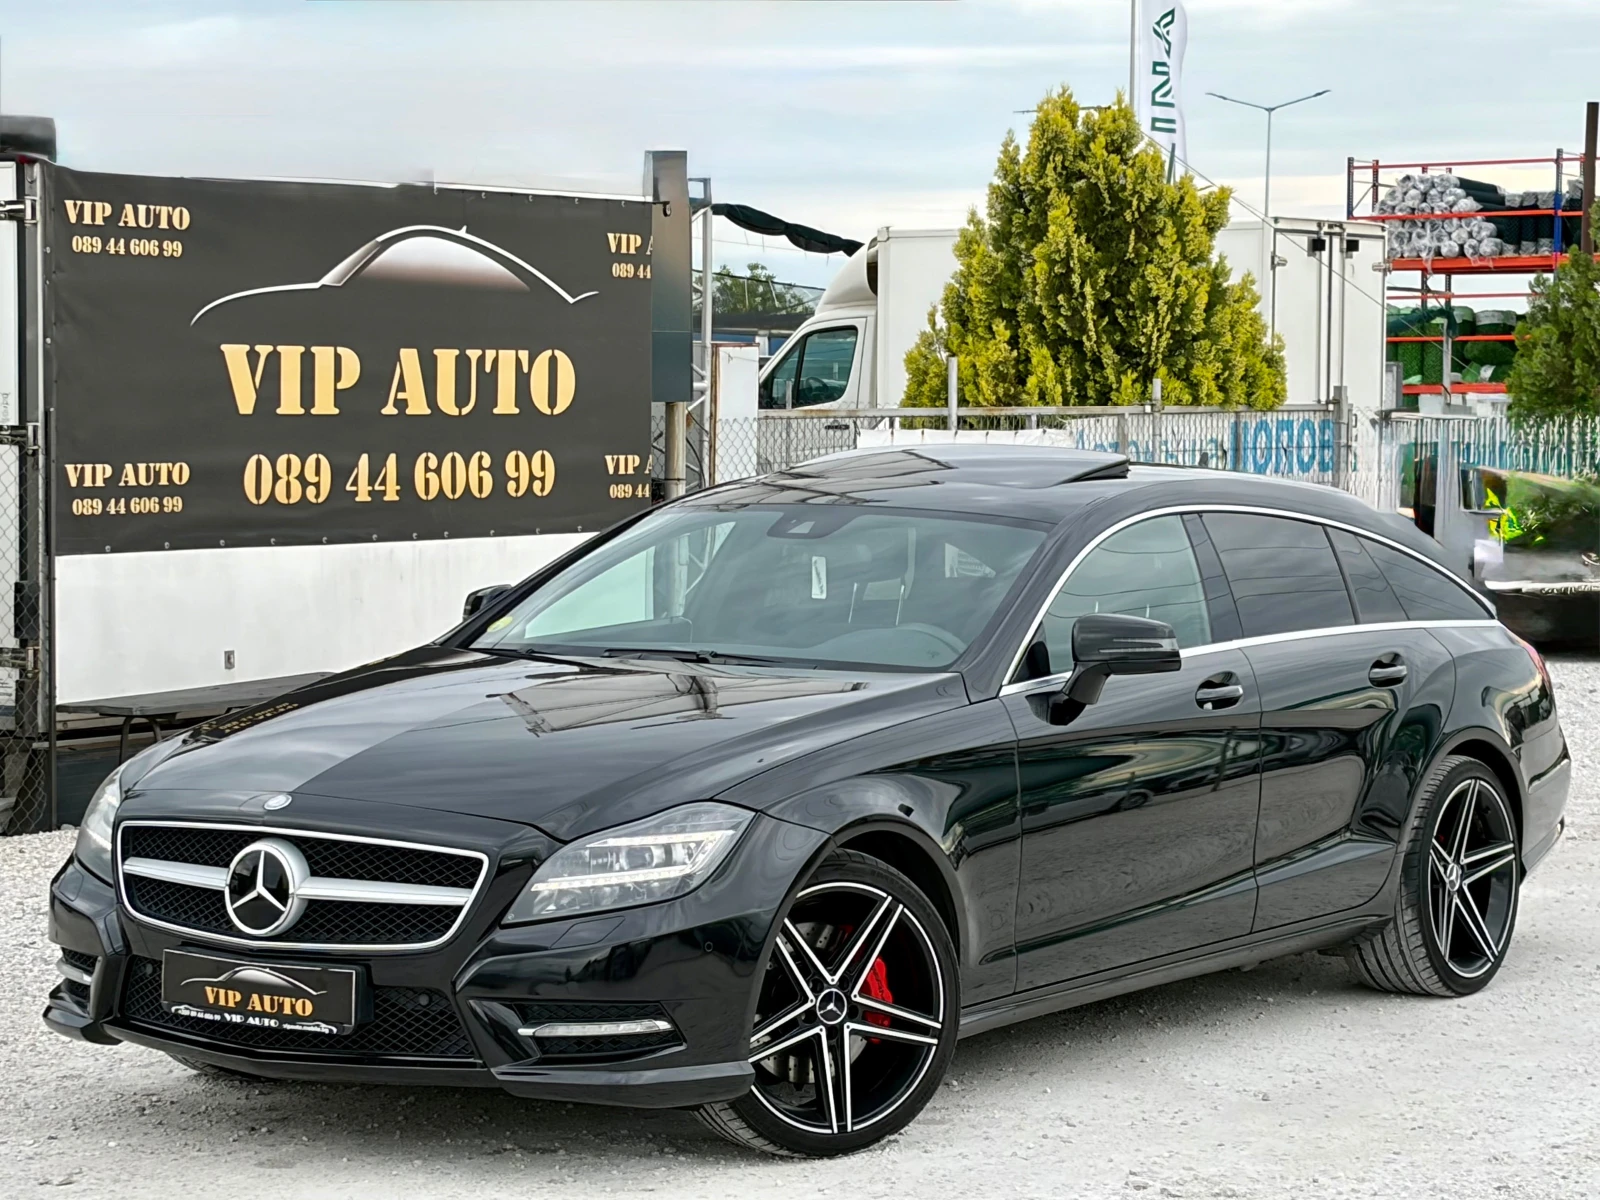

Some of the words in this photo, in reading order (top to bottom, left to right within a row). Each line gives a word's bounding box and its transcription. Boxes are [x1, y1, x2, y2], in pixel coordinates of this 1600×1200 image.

[64, 199, 112, 226] VIP
[117, 203, 191, 230] AUTO
[71, 235, 102, 254] 089
[105, 237, 126, 255] 44
[129, 238, 160, 257] 606
[163, 240, 183, 258] 99
[606, 232, 642, 255] VIP
[611, 262, 635, 278] 089
[636, 264, 652, 279] 44
[219, 343, 361, 415] VIP
[380, 347, 576, 416] AUTO
[64, 463, 113, 488] VIP
[118, 461, 190, 487] AUTO
[604, 454, 641, 475] VIP
[243, 453, 332, 505] 089
[345, 452, 401, 502] 44
[414, 450, 494, 501] 606
[504, 449, 556, 498] 99
[609, 483, 633, 499] 089
[635, 483, 651, 498] 44
[72, 498, 103, 516] 089
[105, 497, 126, 515] 44
[129, 496, 160, 514] 606
[162, 496, 183, 513] 99
[204, 985, 242, 1008] VIP
[246, 993, 313, 1017] AUTO
[223, 1012, 245, 1023] VIP
[246, 1016, 279, 1027] AUTO
